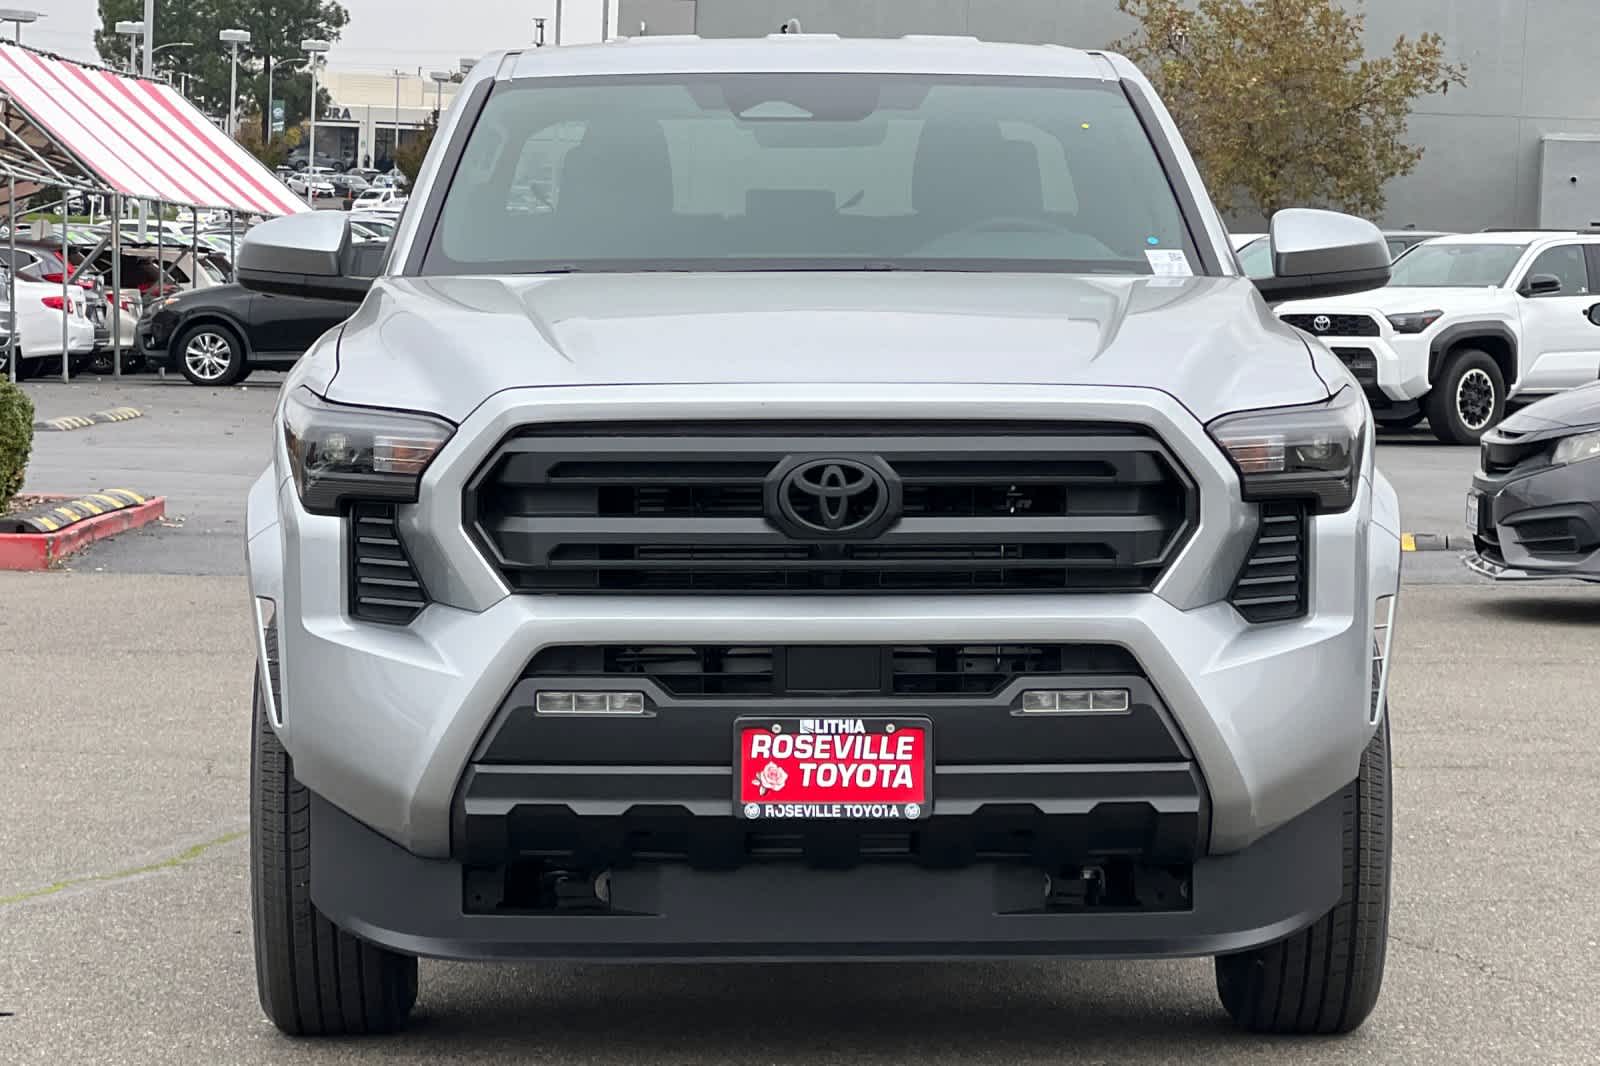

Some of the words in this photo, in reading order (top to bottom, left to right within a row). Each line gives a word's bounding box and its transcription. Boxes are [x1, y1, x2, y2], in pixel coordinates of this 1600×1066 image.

[814, 719, 866, 734] LITHIA
[751, 734, 915, 760] ROSEVILLE
[800, 763, 913, 789] TOYOTA
[765, 805, 841, 818] ROSEVILLE
[844, 805, 899, 818] TOYOTA
